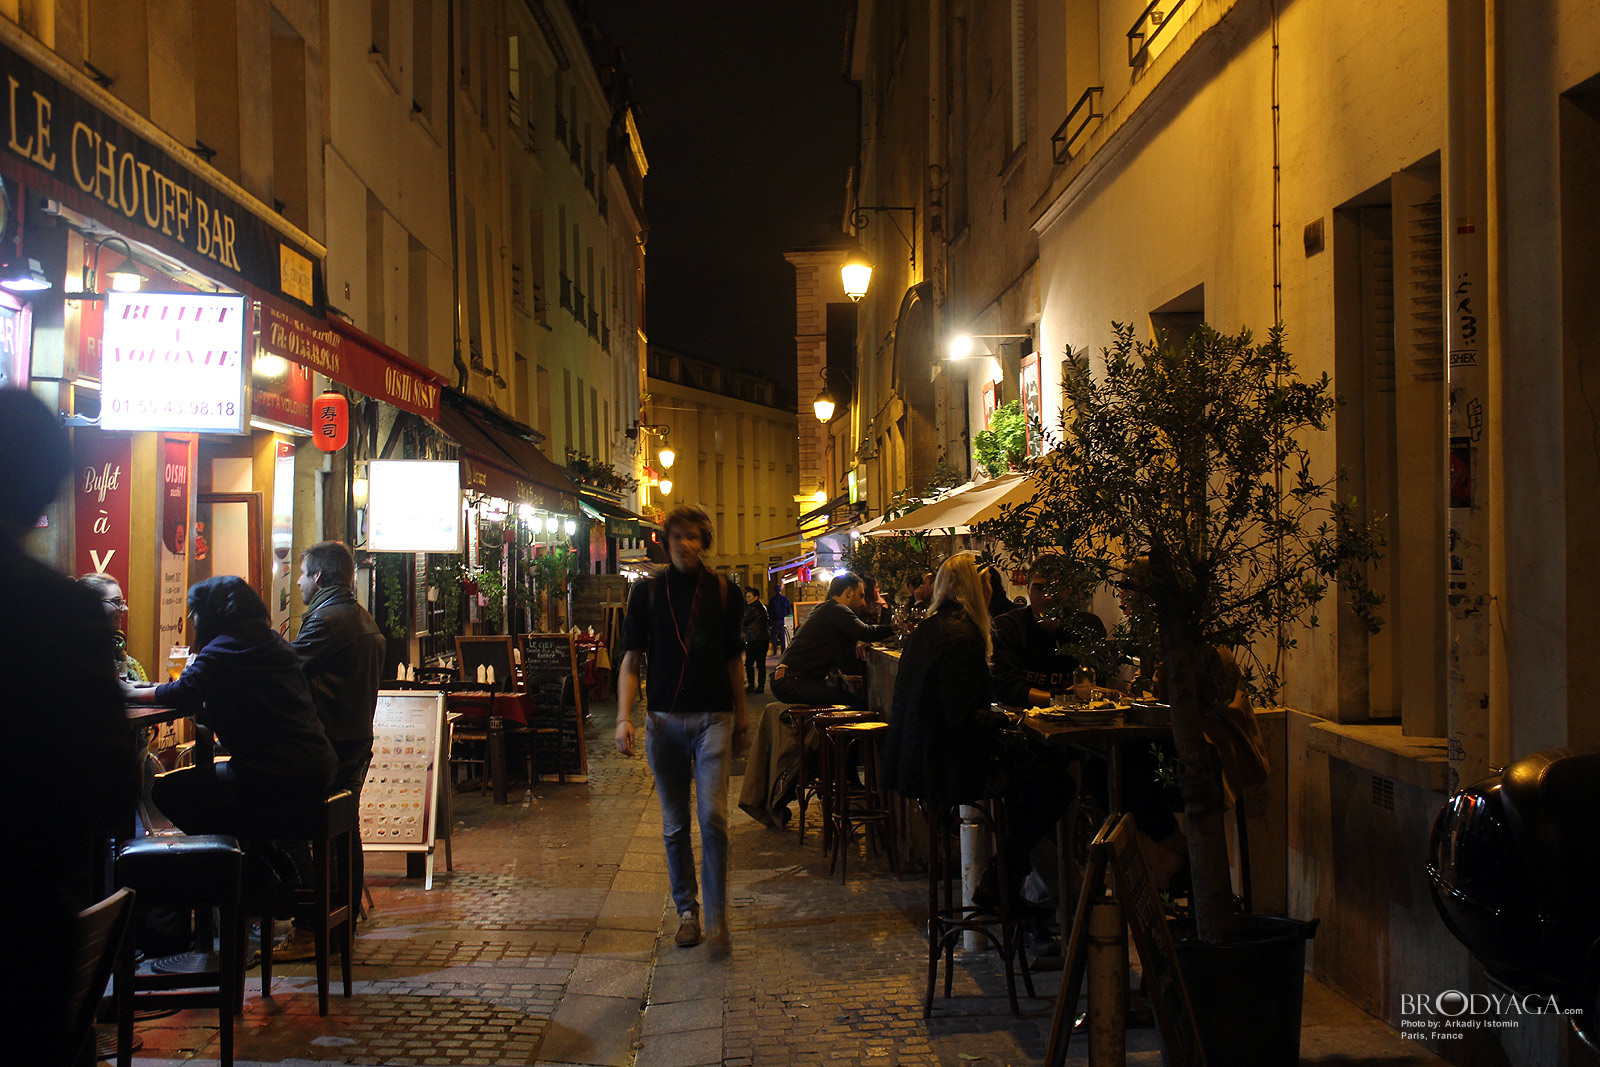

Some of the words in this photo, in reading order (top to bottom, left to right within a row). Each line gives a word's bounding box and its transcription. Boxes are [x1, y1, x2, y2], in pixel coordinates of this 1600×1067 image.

[8, 74, 57, 171] LE
[321, 405, 337, 438] 寿司
[83, 462, 122, 503] Buffet
[165, 463, 188, 485] OISHI
[92, 509, 111, 534] à
